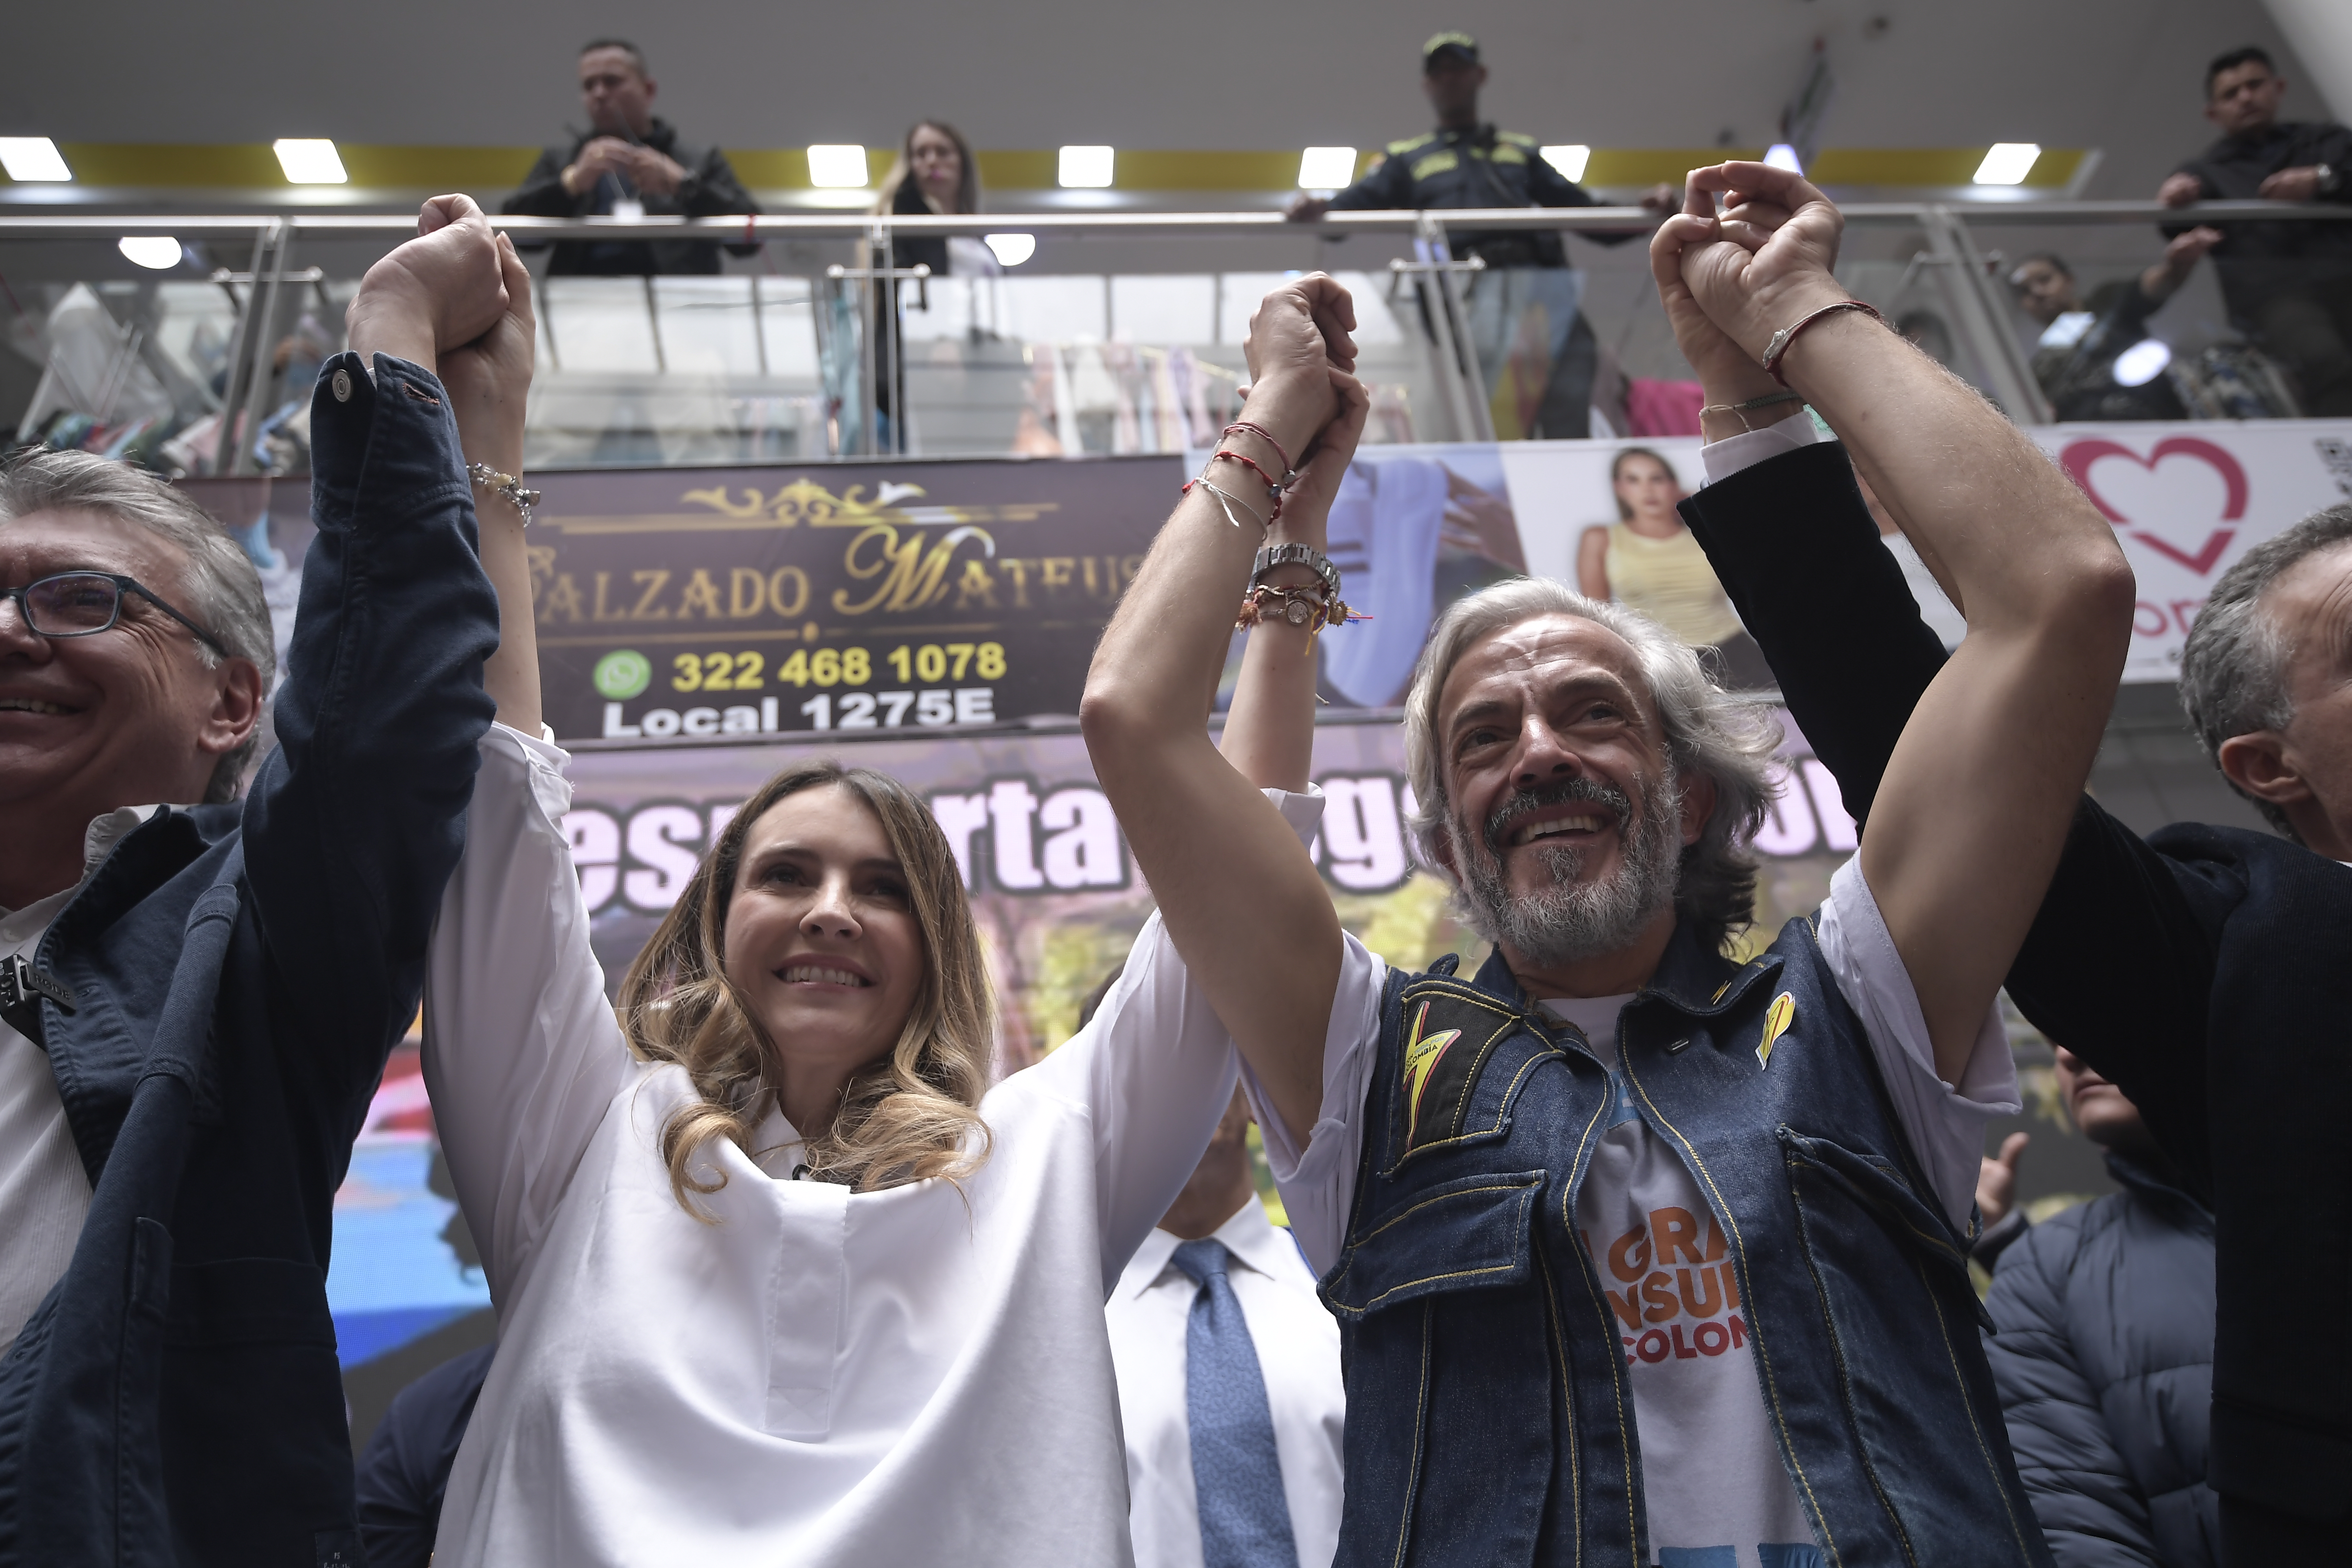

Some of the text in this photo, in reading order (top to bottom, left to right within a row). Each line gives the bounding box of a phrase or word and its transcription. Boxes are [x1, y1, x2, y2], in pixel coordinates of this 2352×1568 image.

[672, 641, 1007, 693] 322 468 1078
[602, 686, 997, 738] Local 1275E
